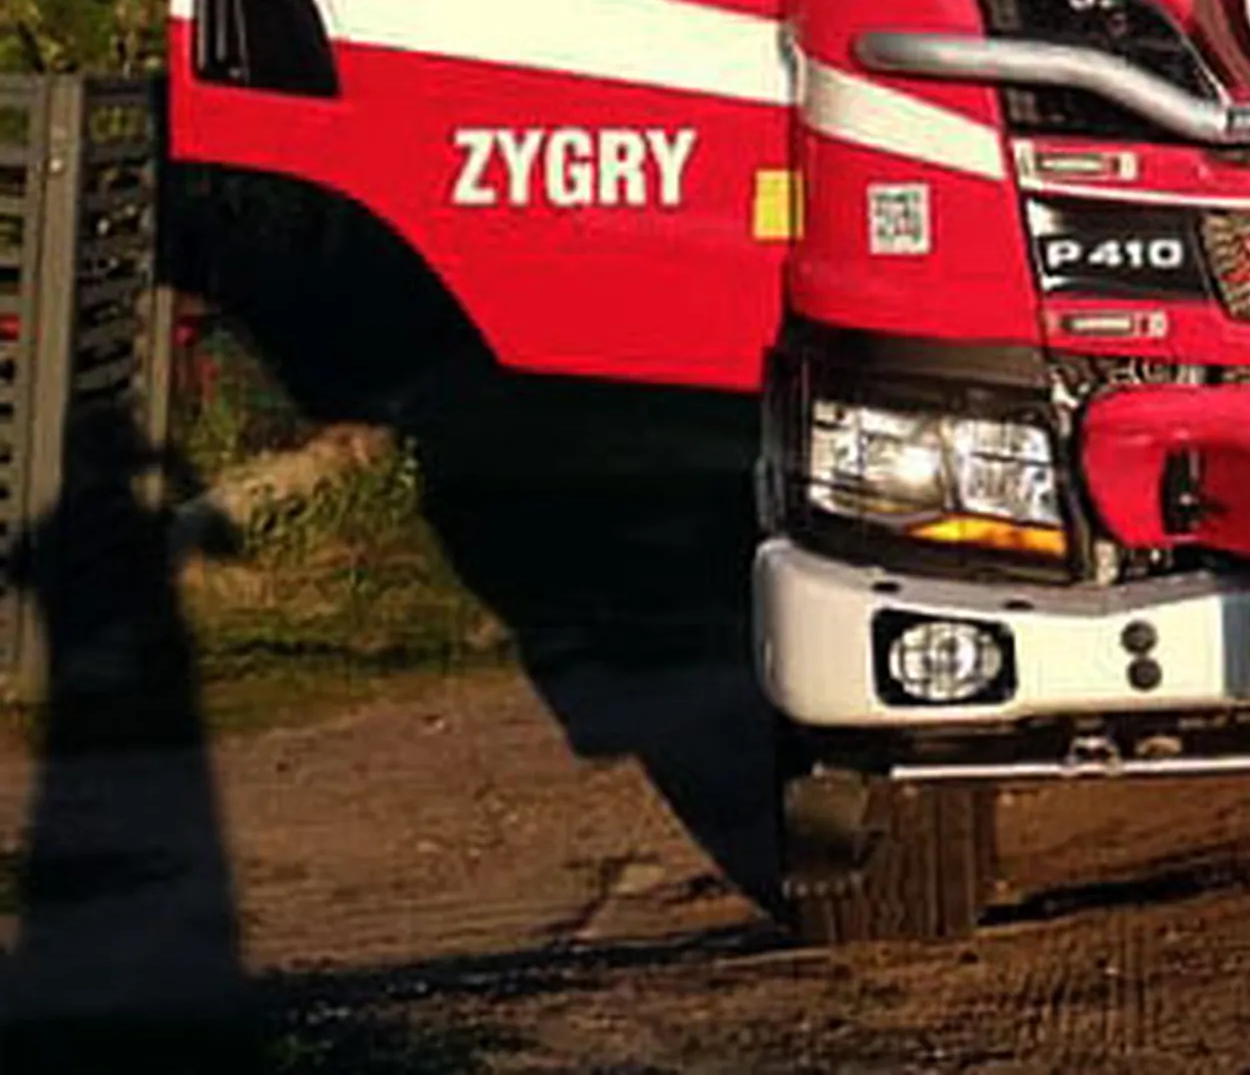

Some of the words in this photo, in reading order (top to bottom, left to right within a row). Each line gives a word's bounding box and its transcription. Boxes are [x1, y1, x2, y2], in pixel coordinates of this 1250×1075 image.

[452, 128, 697, 207] ZYGRY
[1047, 241, 1081, 268] P
[1089, 239, 1183, 268] 410
